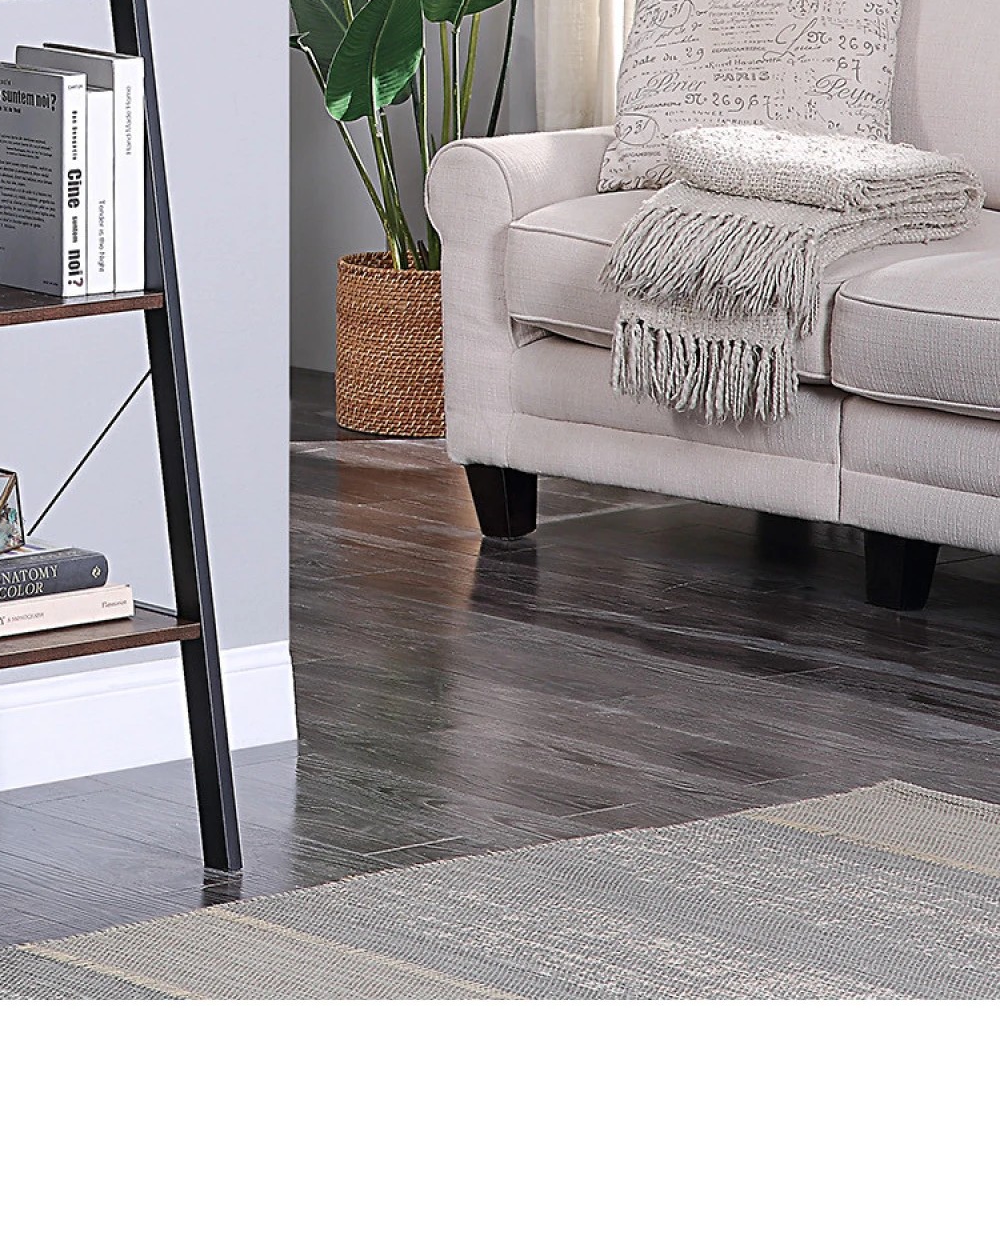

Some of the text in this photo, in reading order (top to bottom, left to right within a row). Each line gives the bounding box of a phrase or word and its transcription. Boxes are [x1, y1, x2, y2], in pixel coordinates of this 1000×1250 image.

[2, 89, 34, 106] suntem
[67, 168, 82, 209] Cine
[67, 249, 83, 287] noi?
